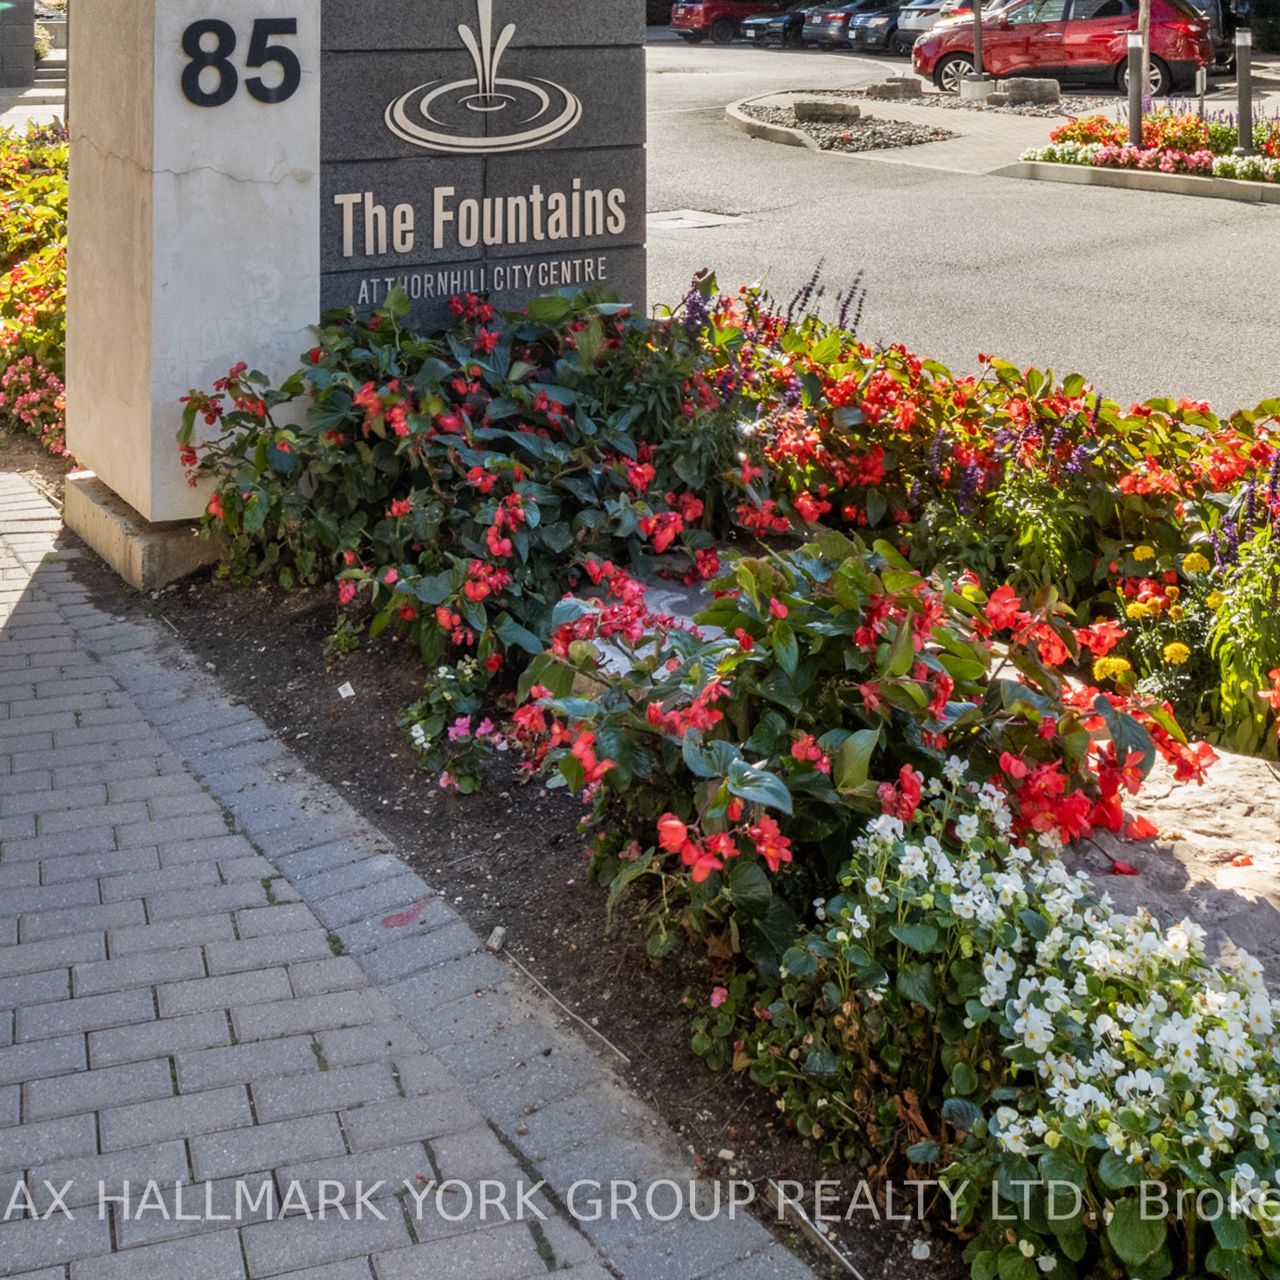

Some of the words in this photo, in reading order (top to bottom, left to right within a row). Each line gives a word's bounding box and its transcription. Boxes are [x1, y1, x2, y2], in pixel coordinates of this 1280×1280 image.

[180, 17, 302, 107] 85
[333, 191, 415, 258] The
[432, 177, 627, 250] Fountains
[357, 278, 381, 305] AT
[493, 264, 534, 292] CITY
[538, 256, 608, 287] CENTRE
